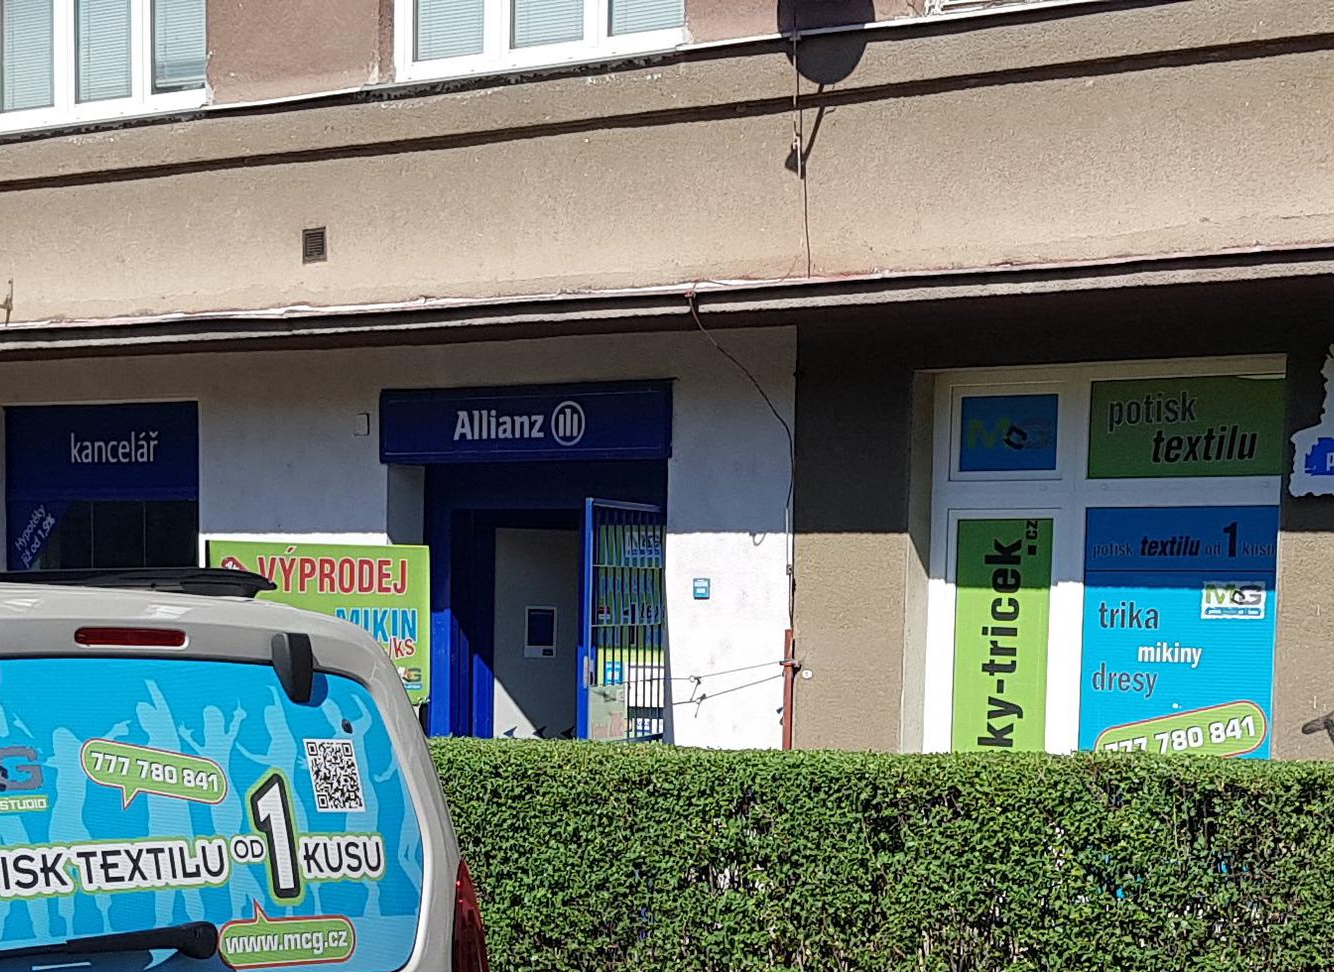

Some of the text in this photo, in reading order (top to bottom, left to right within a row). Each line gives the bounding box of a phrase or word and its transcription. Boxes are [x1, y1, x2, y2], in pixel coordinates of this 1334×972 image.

[453, 409, 545, 440] Allianz
[1108, 391, 1196, 432] potisk
[70, 431, 159, 463] kancelář
[1152, 425, 1258, 463] textilu
[1140, 536, 1201, 557] textilu
[1224, 521, 1238, 557] 1
[258, 546, 408, 594] VÝPRODEJ
[1098, 602, 1160, 629] trika
[1137, 642, 1203, 668] mikiny
[1092, 662, 1158, 698] dresy
[1154, 725, 1204, 755] 780
[1208, 715, 1256, 742] 841
[90, 752, 218, 792] 777 780 841
[0, 797, 48, 811] STUDIO
[77, 840, 226, 884] TEXTILU
[234, 839, 264, 859] OD
[250, 773, 301, 899] 1
[303, 840, 381, 874] KUSU
[225, 930, 348, 955] www.mcg.cz
